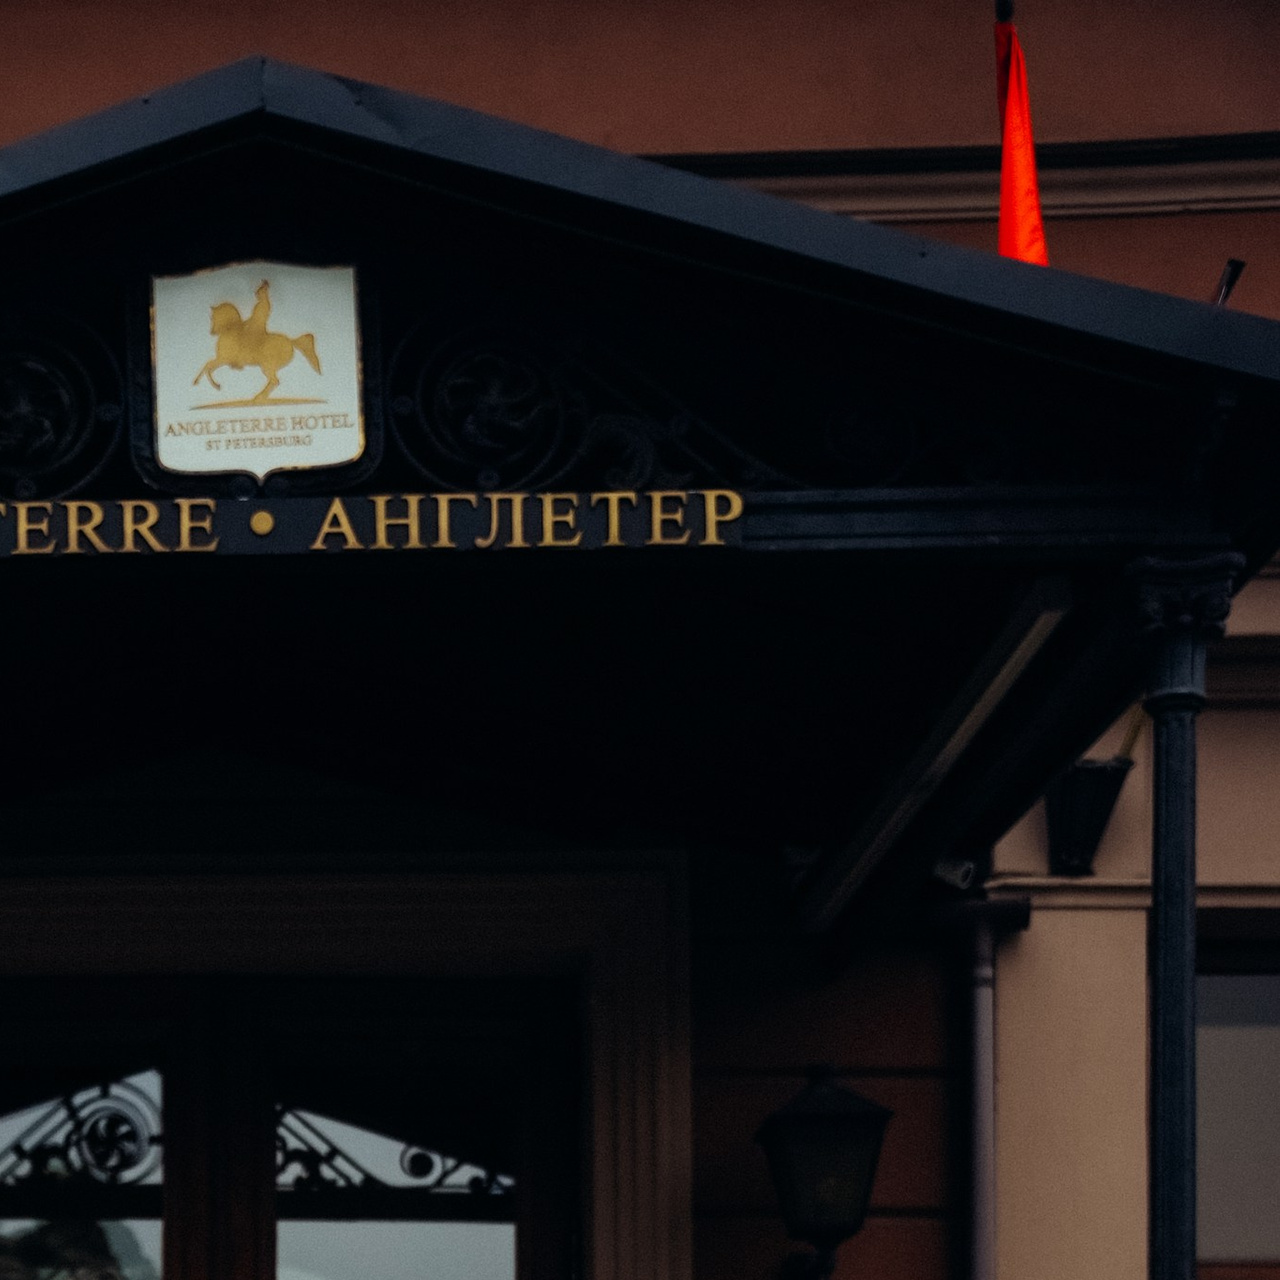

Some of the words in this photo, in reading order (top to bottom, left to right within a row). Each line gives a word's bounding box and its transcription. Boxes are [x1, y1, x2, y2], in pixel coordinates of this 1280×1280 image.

[164, 415, 286, 437] ANGLETERRE
[291, 413, 355, 431] HOTEL
[206, 438, 221, 451] ST
[225, 435, 313, 450] PETERSBURG
[310, 490, 744, 550] АНГЛЕТЕР
